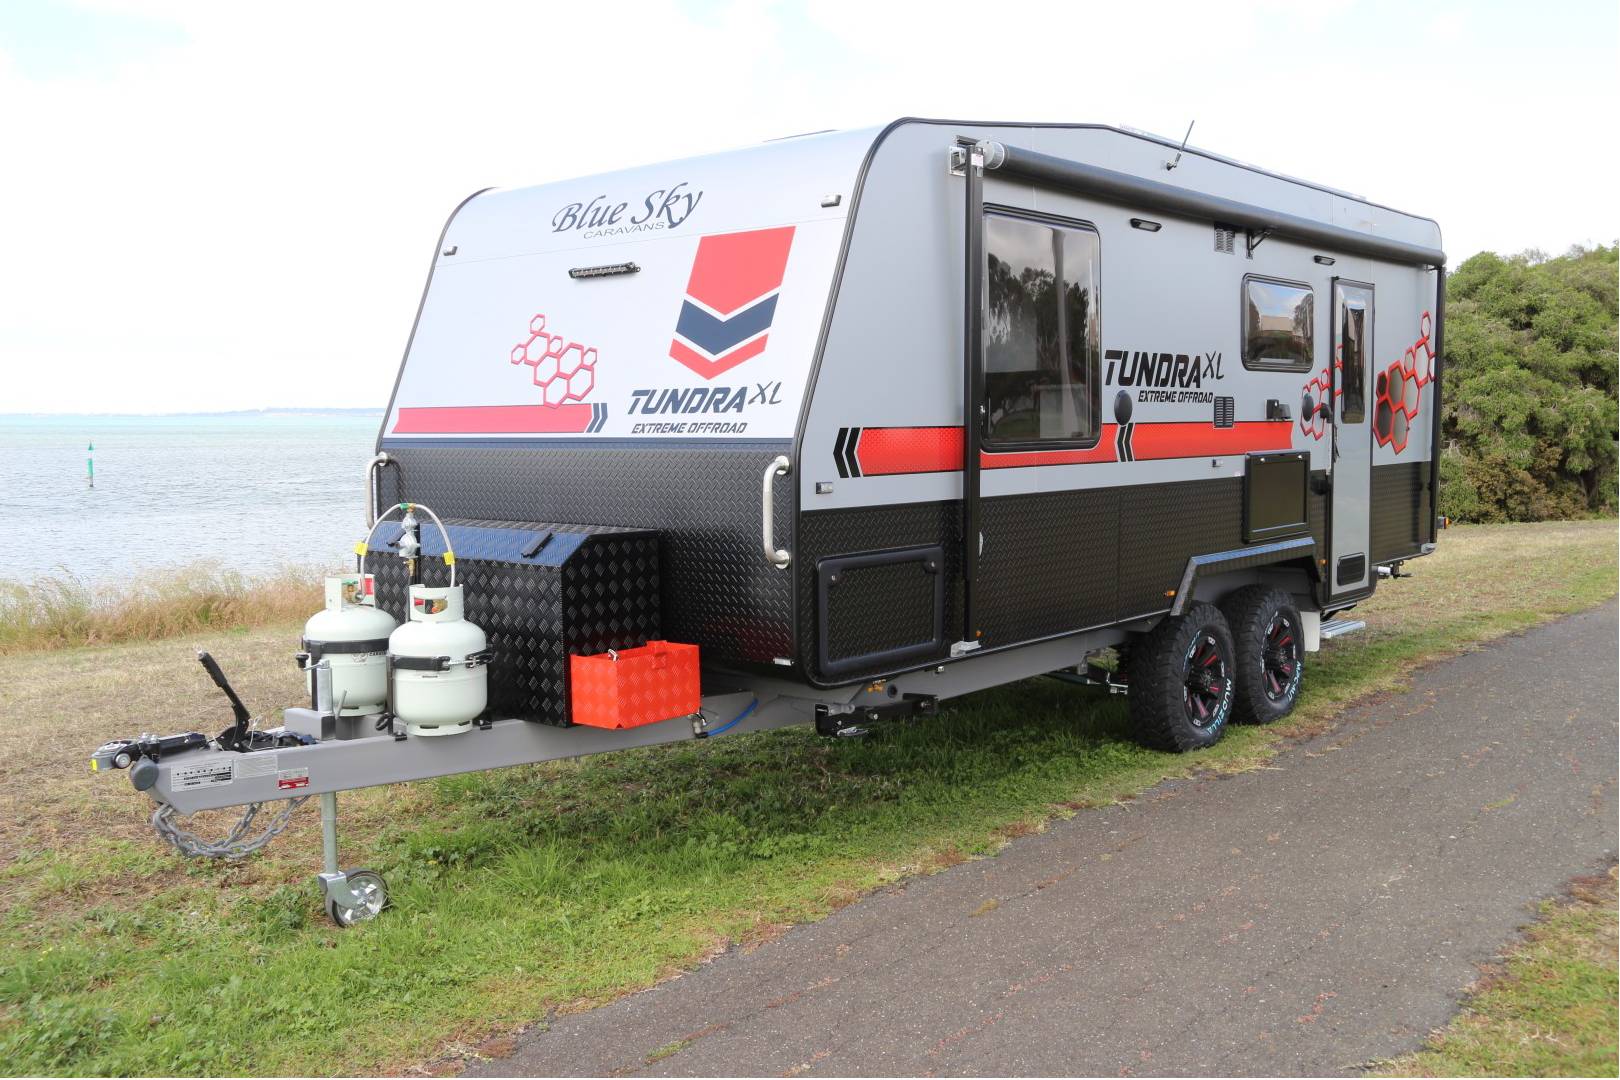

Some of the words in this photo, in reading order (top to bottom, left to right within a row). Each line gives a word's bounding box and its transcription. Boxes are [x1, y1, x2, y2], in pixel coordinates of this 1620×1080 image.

[551, 195, 628, 233] Blue
[630, 182, 703, 229] Sky
[583, 221, 665, 239] CARAVANS
[1105, 349, 1201, 388] TUNDRA
[1202, 350, 1225, 380] XL
[627, 387, 748, 415] TUNDRA
[748, 381, 783, 405] XL
[1138, 390, 1177, 403] EXTREME
[1177, 392, 1214, 404] OFFROAD
[631, 423, 687, 434] EXTREME
[687, 422, 748, 434] OFFROAD
